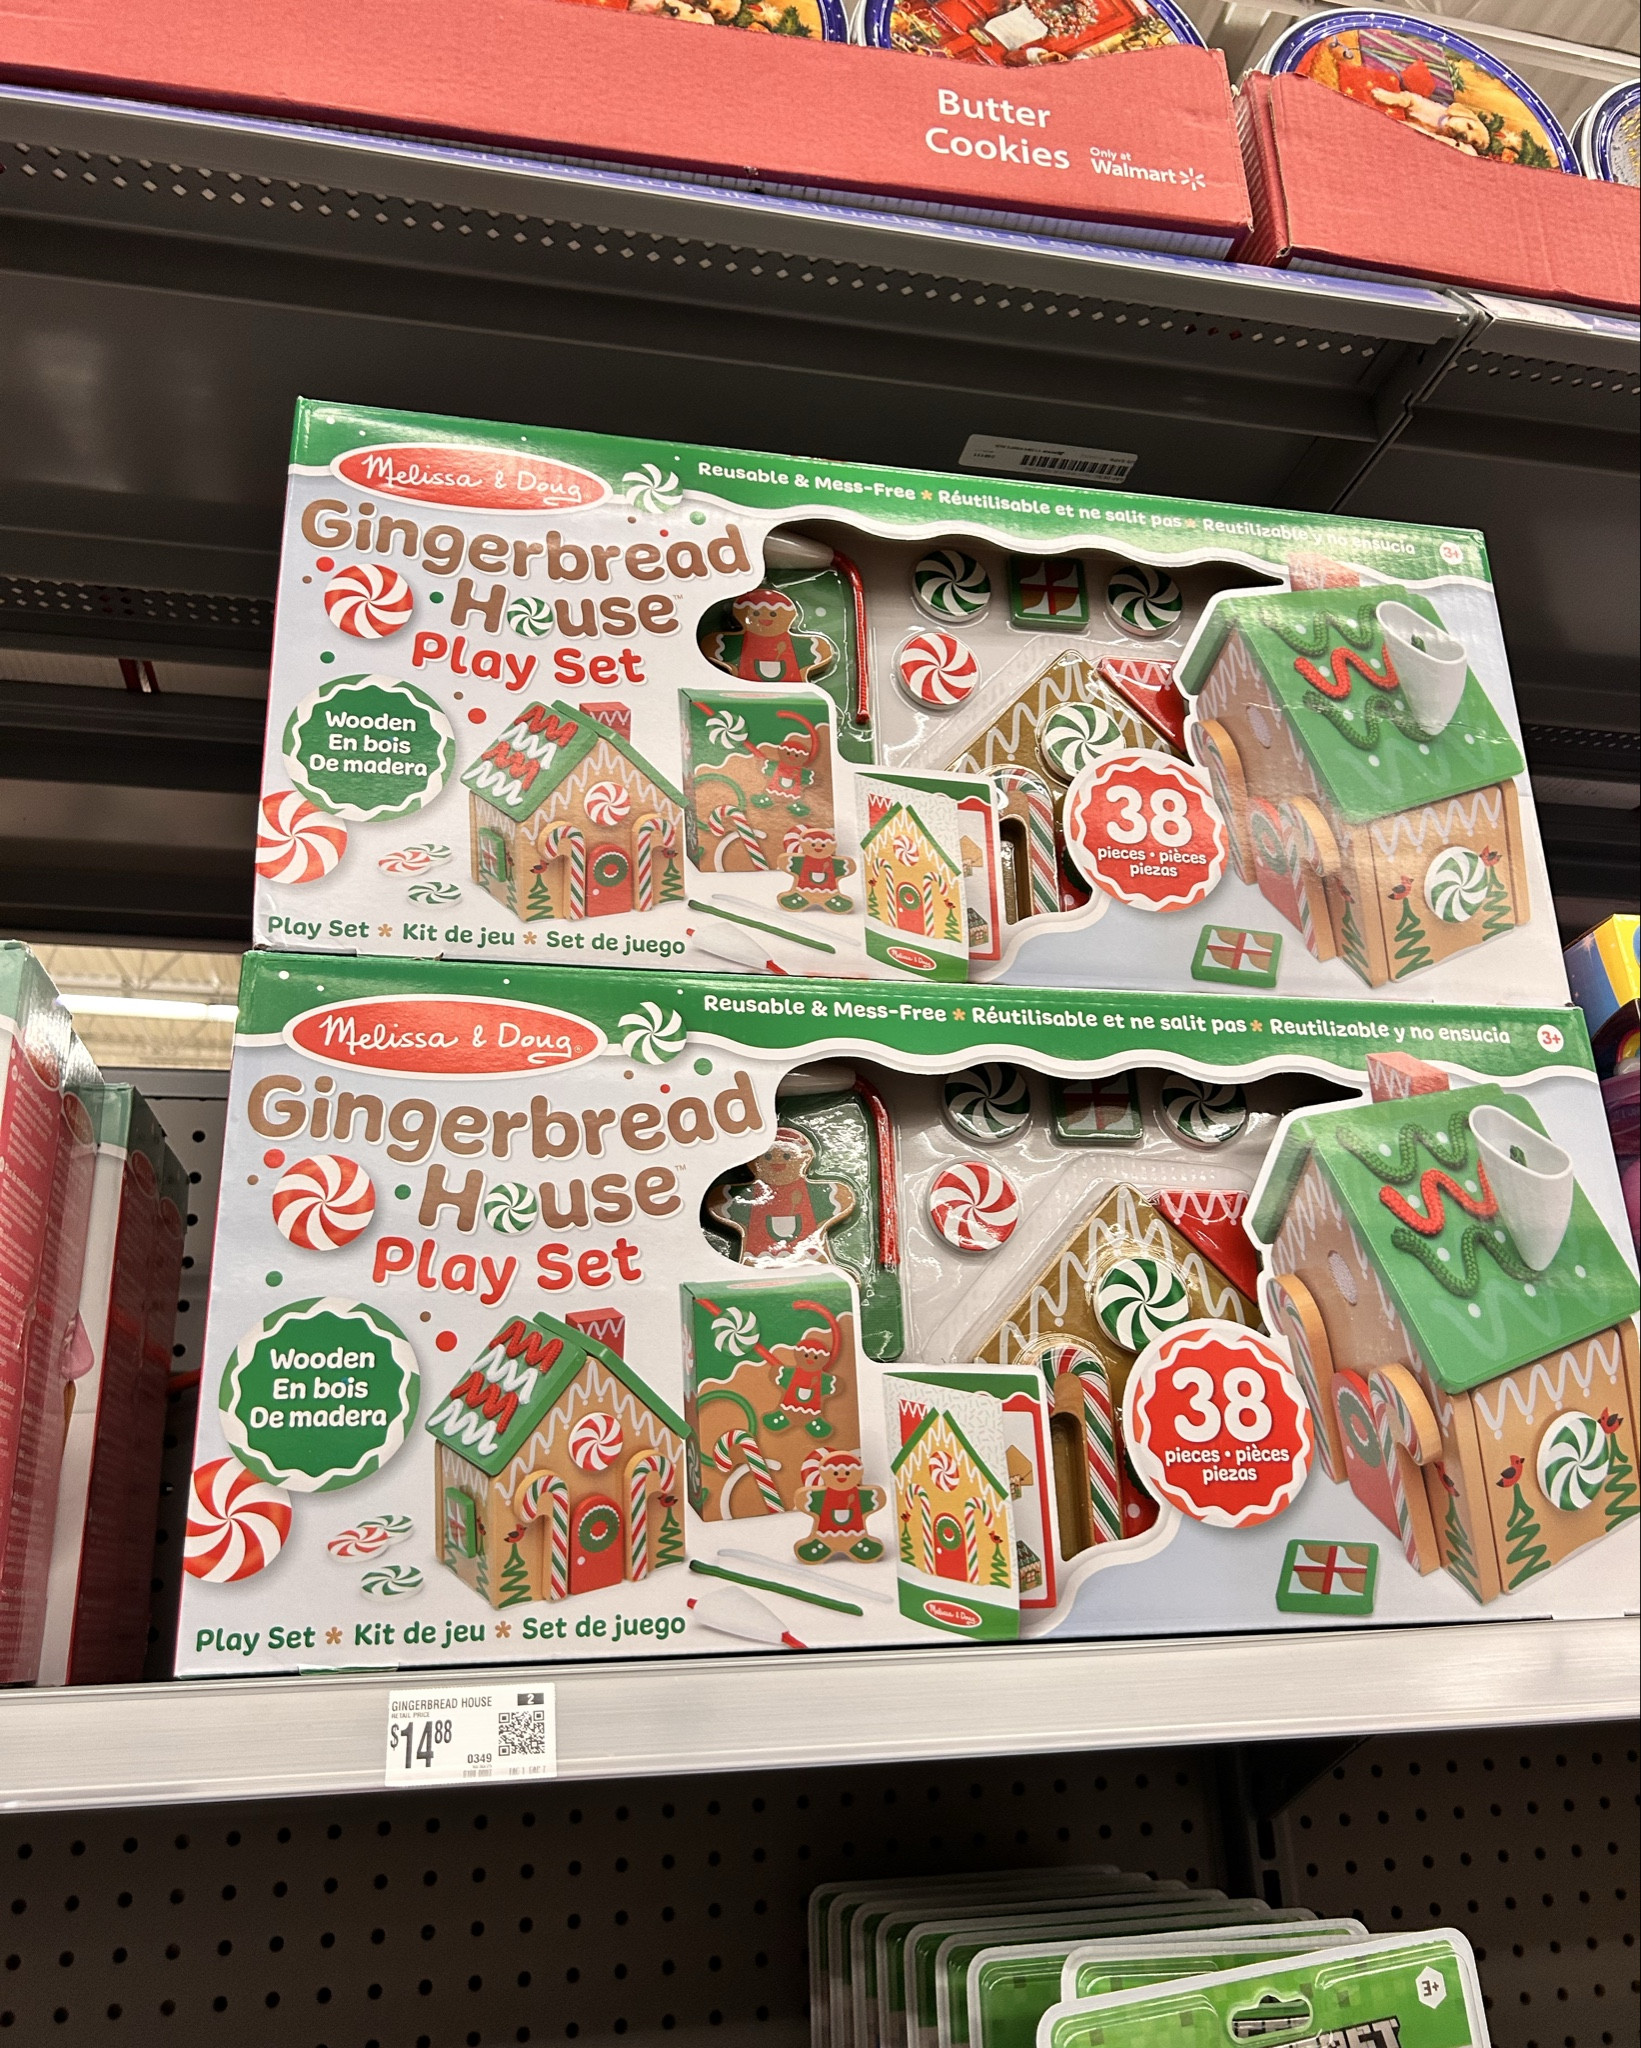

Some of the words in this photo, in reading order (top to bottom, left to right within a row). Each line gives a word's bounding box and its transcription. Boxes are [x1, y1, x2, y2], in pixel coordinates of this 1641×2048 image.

[938, 88, 1051, 128] Butter
[925, 127, 1070, 169] Cookies
[1090, 146, 1118, 161] Only
[1120, 151, 1131, 161] at
[1091, 158, 1177, 184] Walmart
[361, 454, 483, 489] Melissa
[495, 470, 507, 489] &
[517, 472, 582, 505] Doug
[698, 461, 789, 486] Reusable
[793, 472, 810, 488] &
[814, 475, 916, 501] Mess-Free
[938, 488, 1050, 516] Réutilisable
[1055, 501, 1073, 518] et
[1077, 505, 1101, 520] ne
[1105, 507, 1146, 526] salit
[1151, 513, 1182, 530] pas
[1203, 517, 1308, 541] Reutilizable
[1311, 531, 1323, 546] y
[1326, 533, 1347, 546] no
[1351, 535, 1415, 555] ensucia
[301, 499, 752, 582] Gingerbread
[1443, 546, 1460, 560] 3+
[451, 577, 680, 640] House
[412, 631, 537, 692] Play
[553, 648, 647, 686] Set
[325, 710, 417, 733] Wooden
[329, 733, 358, 753] En
[363, 735, 412, 755] bois
[310, 753, 340, 772] De
[343, 755, 428, 778] madera
[1106, 784, 1193, 848] 38
[1097, 845, 1146, 863] pieces
[1159, 845, 1207, 866] pièces
[1129, 861, 1178, 879] piezas
[268, 915, 322, 941] Play
[329, 919, 370, 939] Set
[403, 922, 439, 942] Kit
[444, 923, 474, 945] de
[477, 927, 516, 949] jeu
[546, 930, 585, 950] Set
[591, 931, 618, 952] de
[622, 934, 686, 959] juego
[704, 994, 806, 1016] Reusable
[811, 1000, 829, 1017] &
[834, 1001, 947, 1023] Mess-Free
[972, 1005, 1098, 1029] Réutilisable
[1102, 1012, 1126, 1029] et
[1130, 1016, 1155, 1031] ne
[1160, 1013, 1206, 1033] salit
[1211, 1017, 1247, 1036] pas
[1270, 1018, 1389, 1039] Reutilizable
[1394, 1026, 1405, 1043] y
[1410, 1025, 1434, 1042] no
[1438, 1026, 1511, 1045] ensucia
[318, 1014, 458, 1054] Melissa
[472, 1025, 487, 1047] &
[498, 1022, 572, 1064] Doug
[1541, 1031, 1562, 1046] 3+
[247, 1070, 763, 1163] Gingerbread
[418, 1164, 682, 1234] House
[372, 1236, 517, 1306] Play
[537, 1237, 642, 1291] Set
[270, 1347, 375, 1371] Wooden
[273, 1378, 306, 1399] En
[313, 1376, 369, 1400] bois
[249, 1406, 285, 1429] De
[288, 1404, 387, 1428] madera
[1172, 1367, 1272, 1443] 38
[1165, 1446, 1221, 1466] pieces
[1235, 1445, 1290, 1465] pièces
[1202, 1466, 1257, 1485] piezas
[196, 1627, 260, 1656] Play
[267, 1625, 316, 1648] Set
[354, 1623, 396, 1646] Kit
[403, 1621, 438, 1644] de
[441, 1622, 486, 1648] jeu
[522, 1617, 568, 1641] Set
[575, 1616, 607, 1639] de
[610, 1614, 686, 1640] juego
[392, 1698, 458, 1712] GINGERBREAD
[461, 1696, 492, 1708] HOUSE
[526, 1693, 535, 1705] 2
[467, 1753, 492, 1764] 0349
